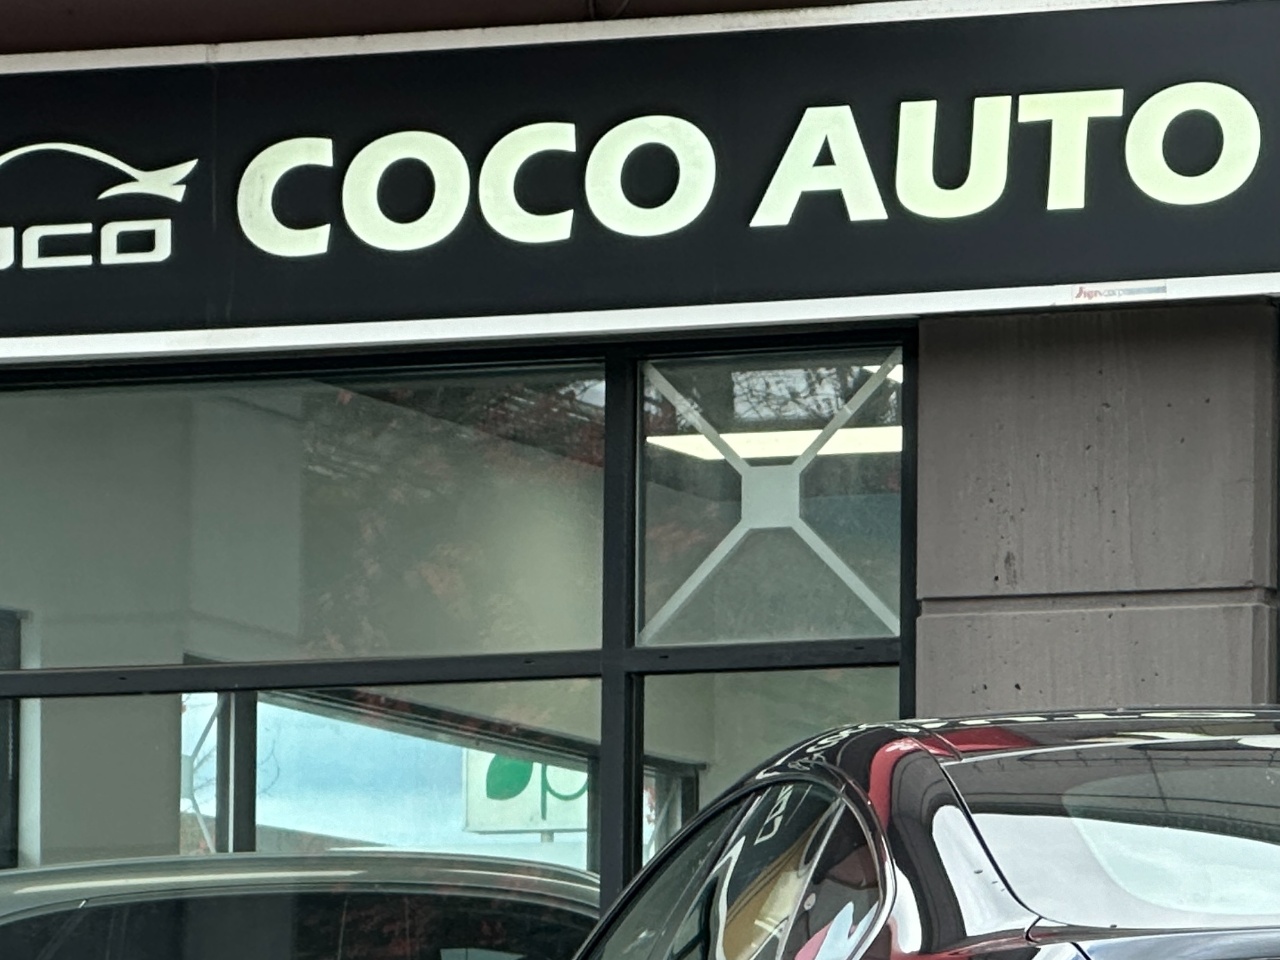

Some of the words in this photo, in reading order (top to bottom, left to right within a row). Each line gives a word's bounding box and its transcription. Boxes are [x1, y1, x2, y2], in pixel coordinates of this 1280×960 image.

[236, 115, 717, 258] COCO
[748, 81, 1262, 228] AUTO
[0, 218, 172, 271] CO
